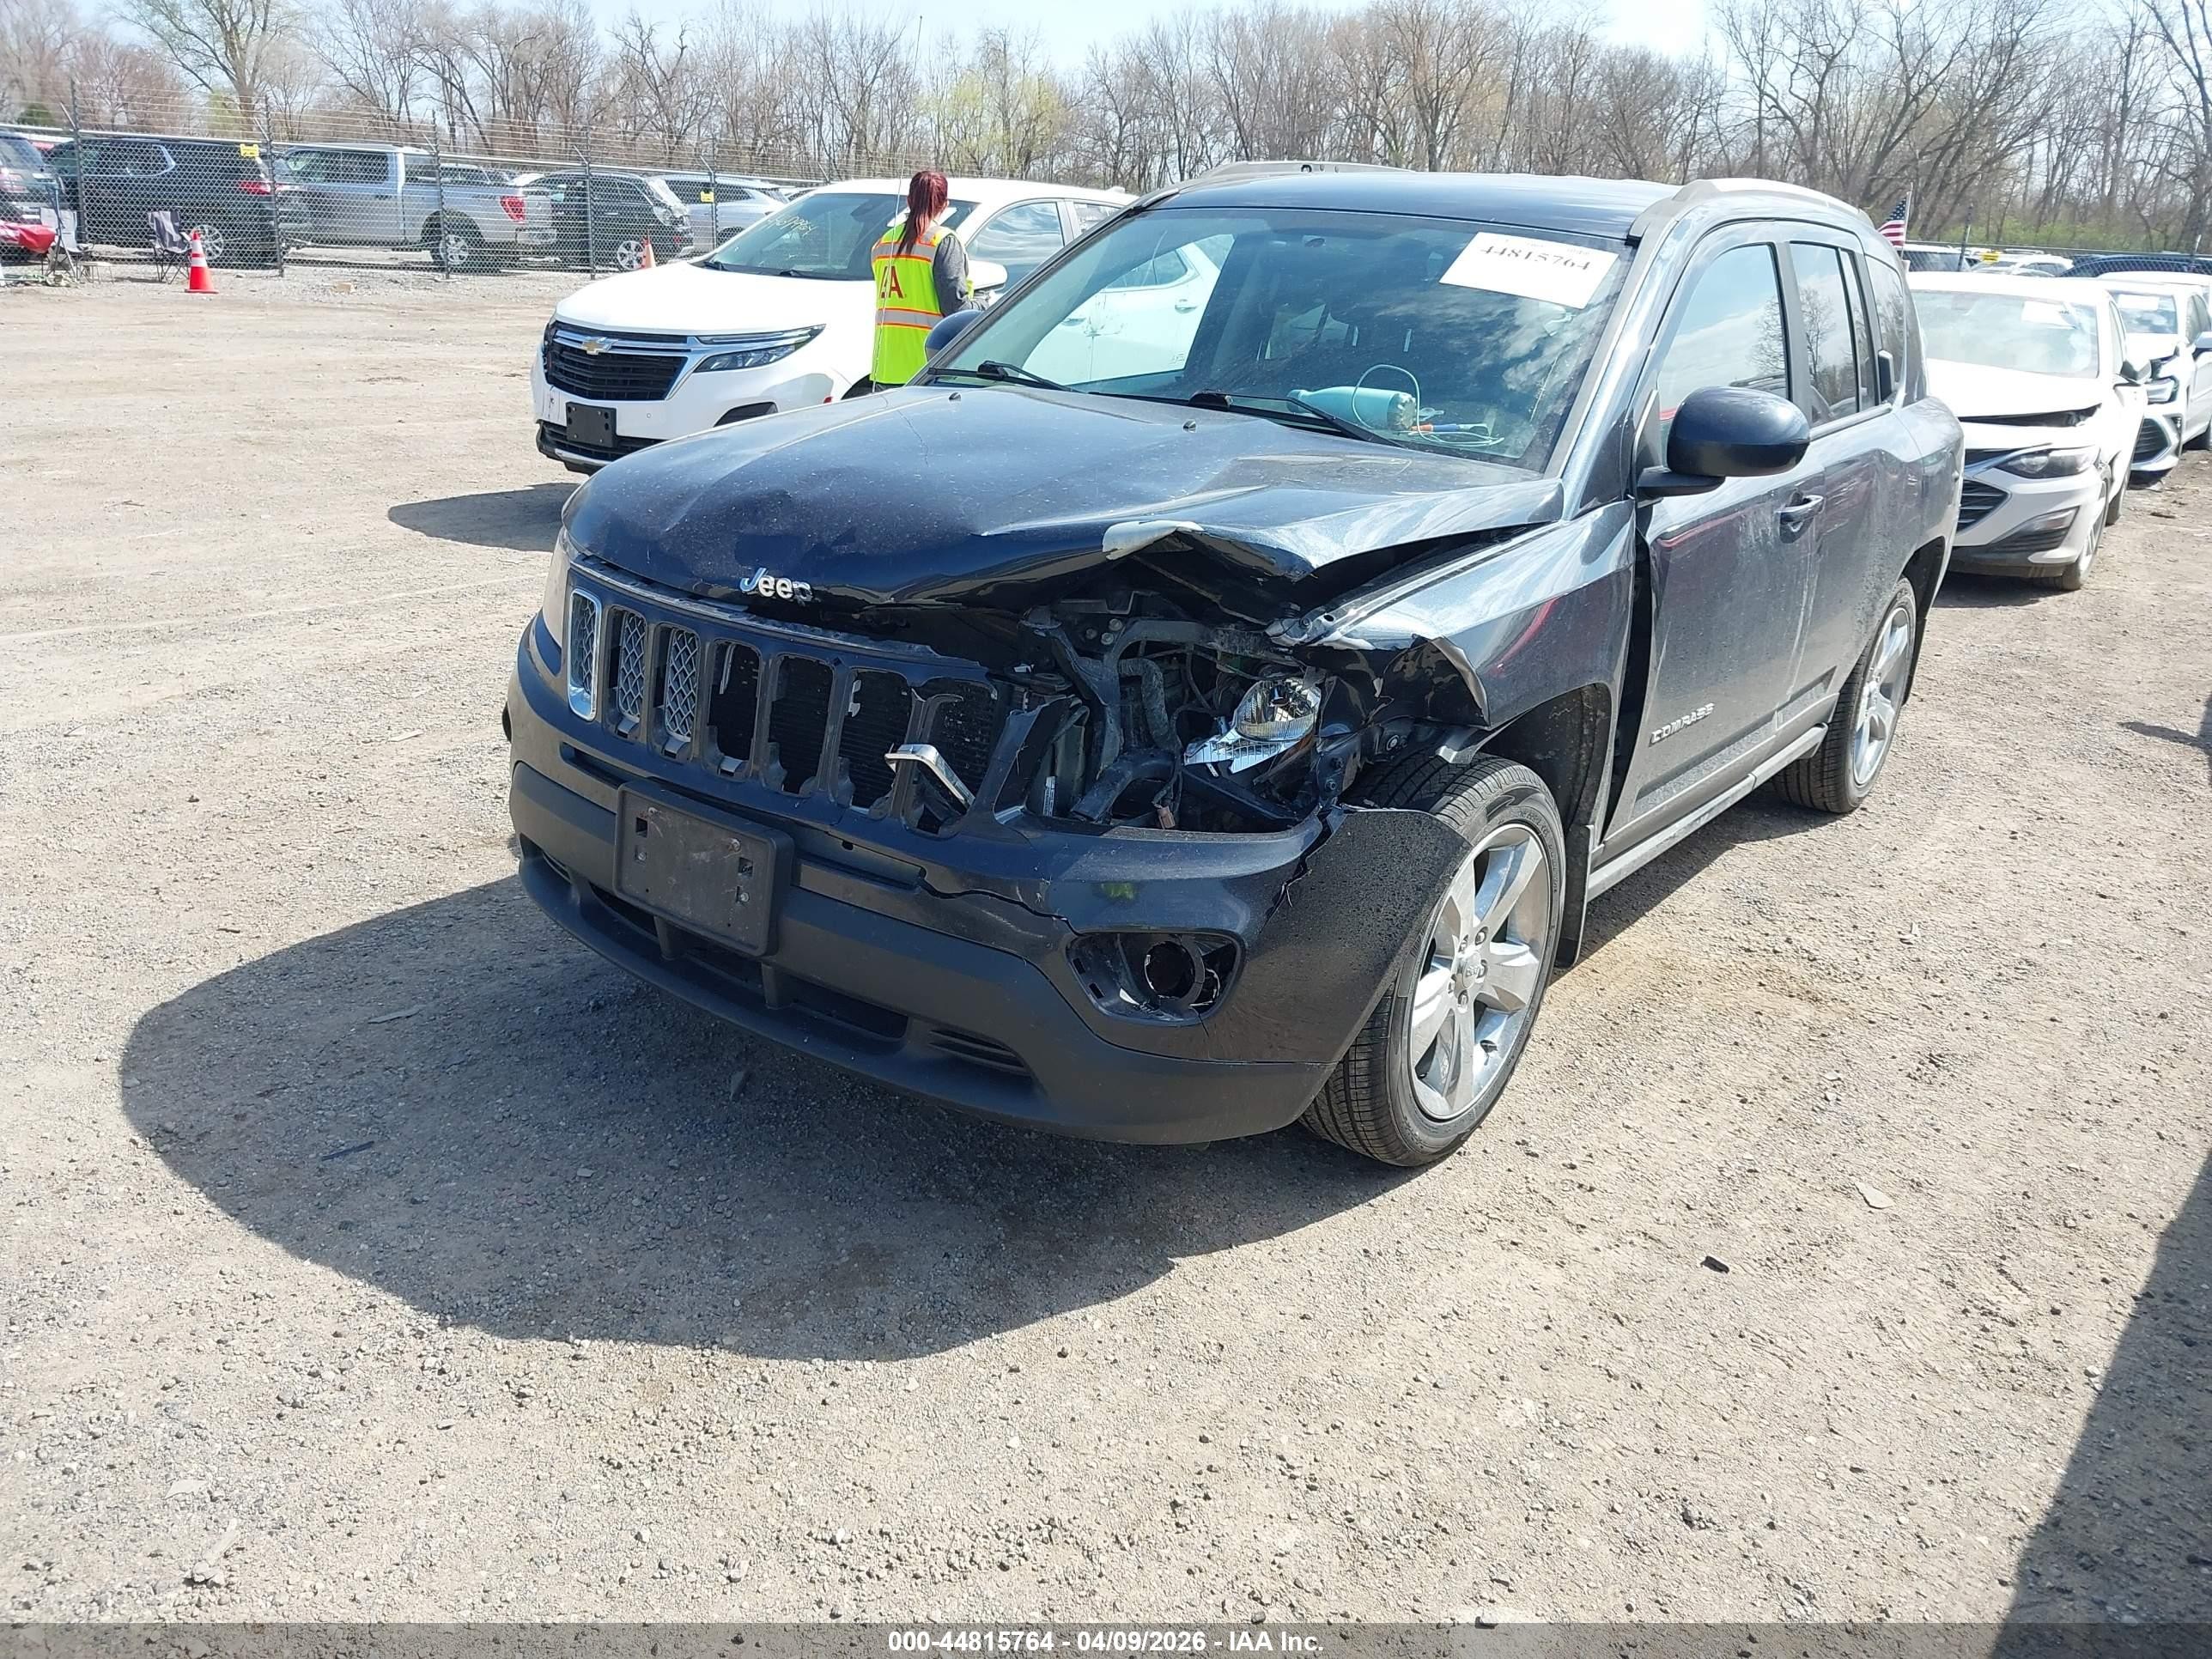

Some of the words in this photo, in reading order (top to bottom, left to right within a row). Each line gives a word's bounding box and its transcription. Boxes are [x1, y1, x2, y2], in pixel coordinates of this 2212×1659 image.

[1480, 245, 1591, 270] 44815764
[739, 567, 813, 606] Jeep
[1650, 702, 1716, 744] COMPASS
